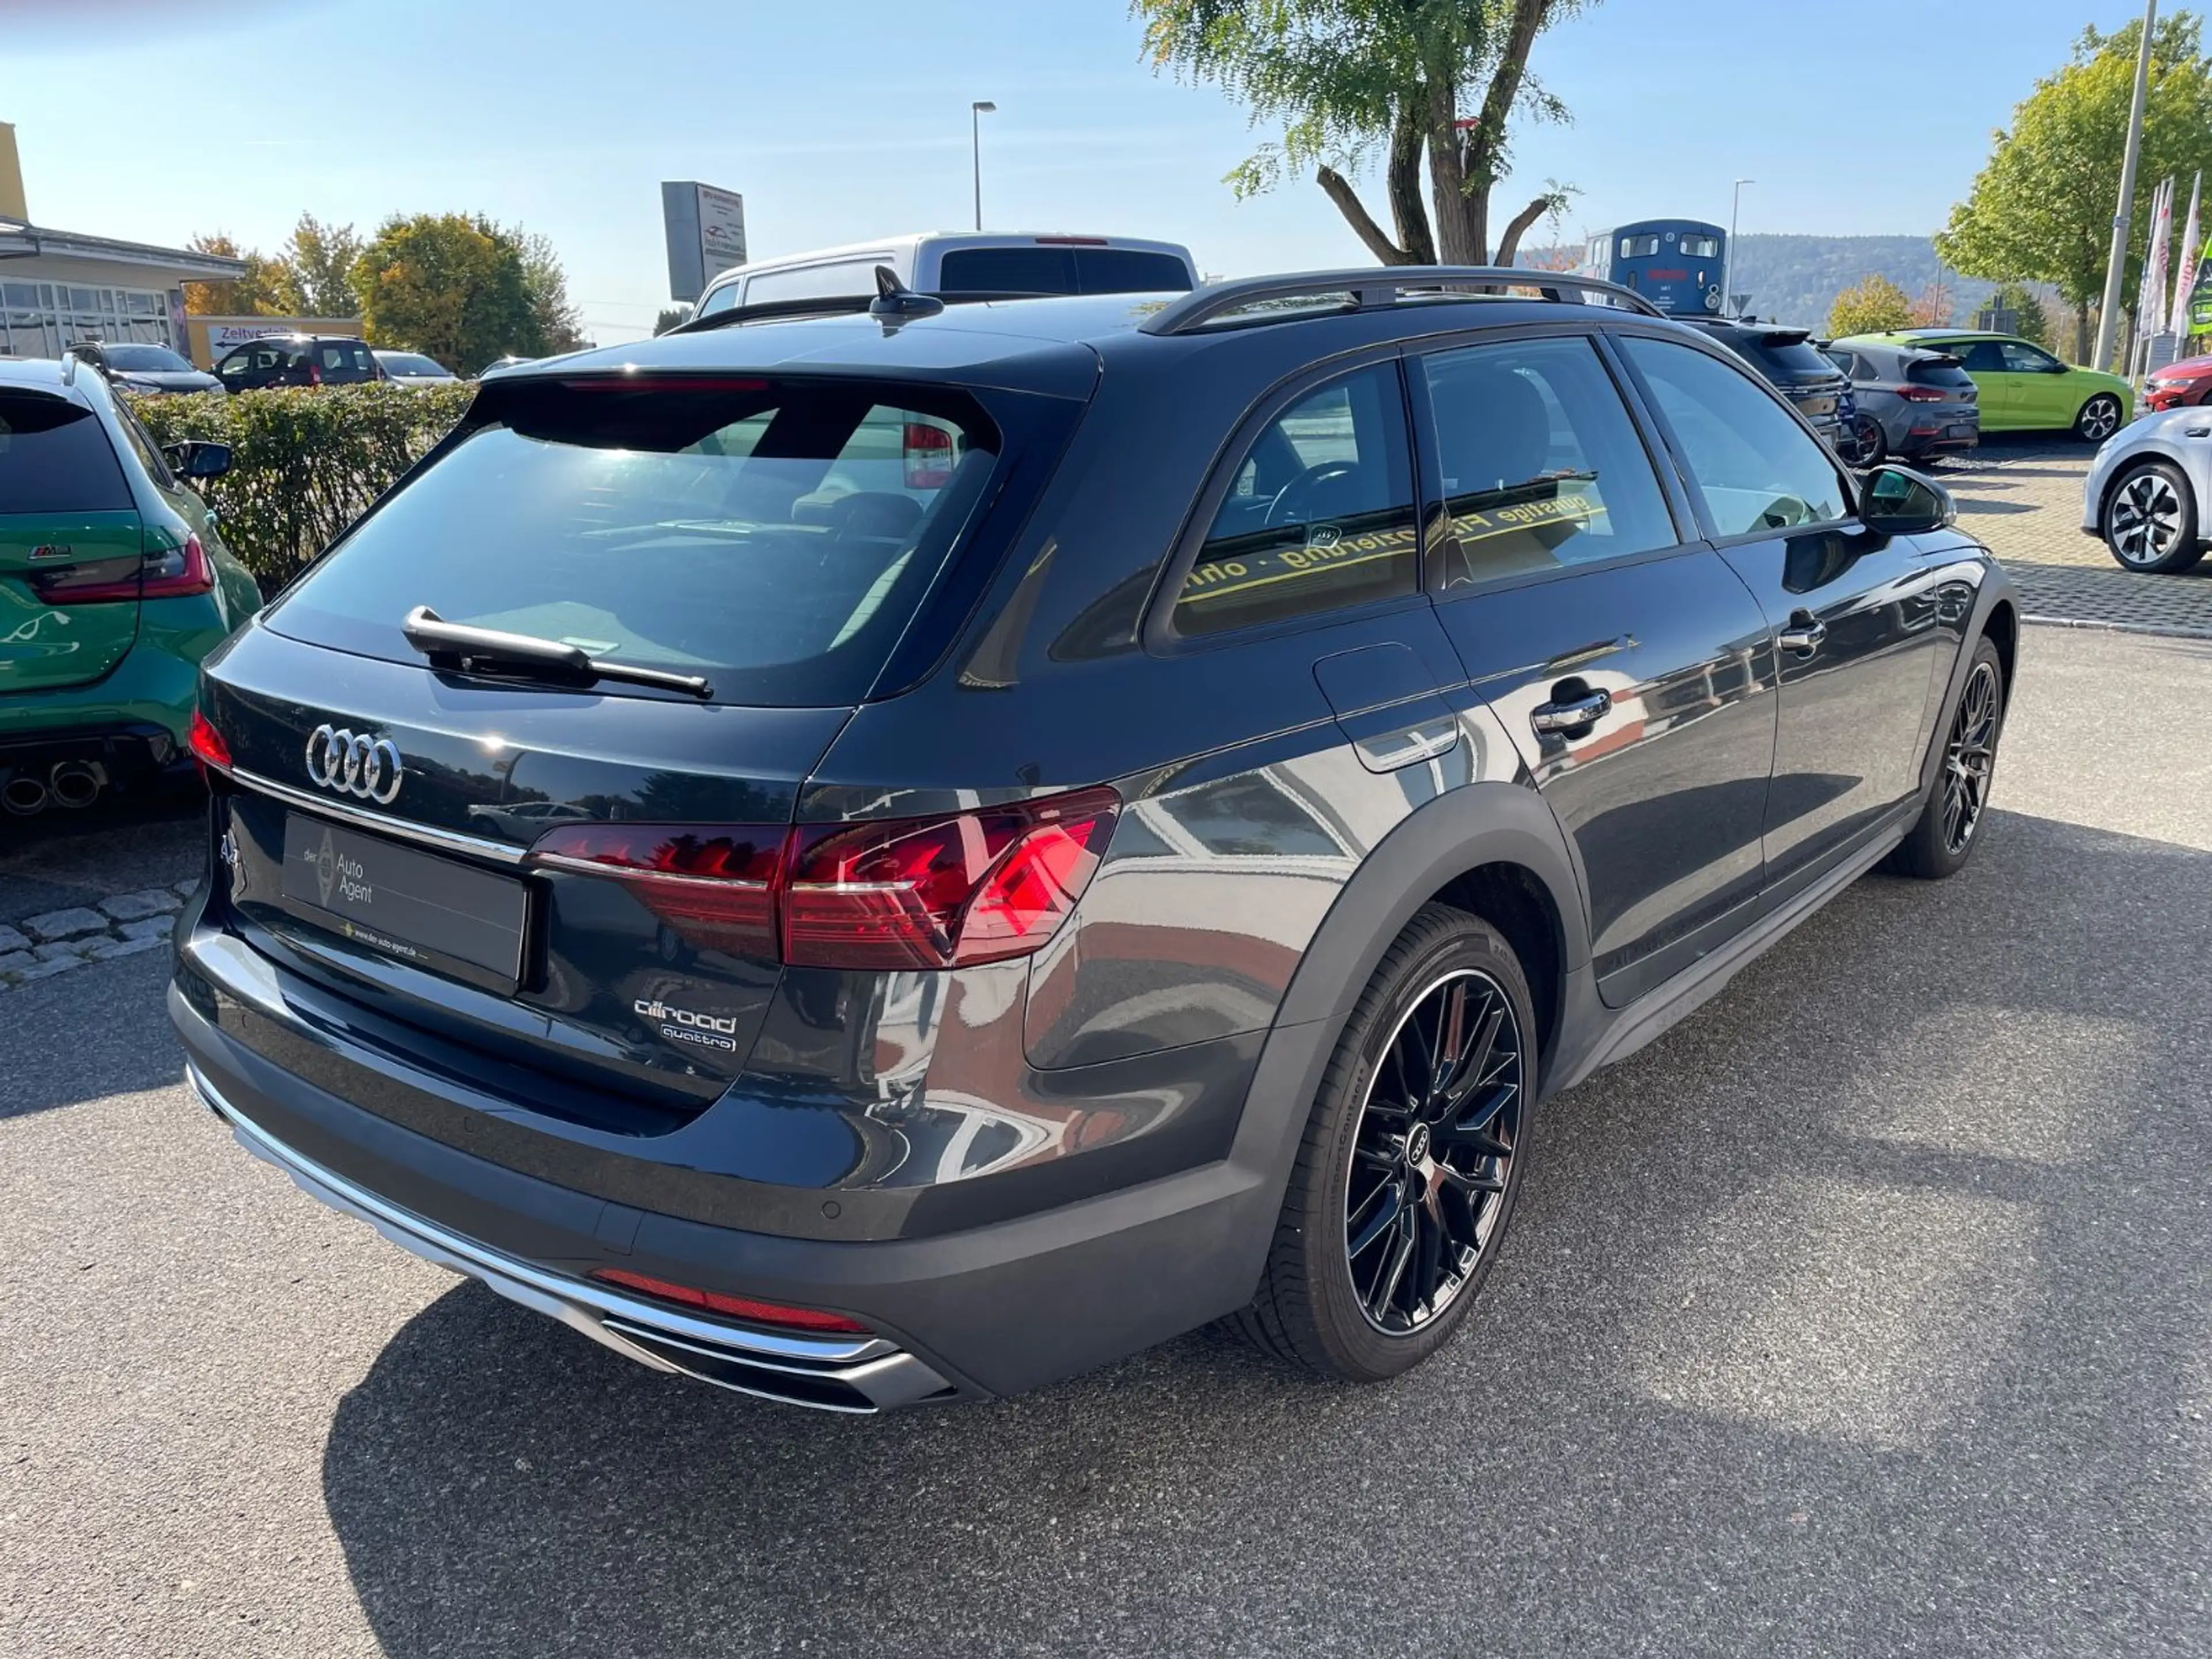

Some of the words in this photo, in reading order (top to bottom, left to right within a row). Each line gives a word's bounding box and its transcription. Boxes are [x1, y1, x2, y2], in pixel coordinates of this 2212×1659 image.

[304, 847, 317, 862] der
[337, 853, 363, 879] Auto
[339, 875, 373, 904] Agent
[634, 999, 737, 1034] allroad
[663, 1028, 731, 1049] quattro
